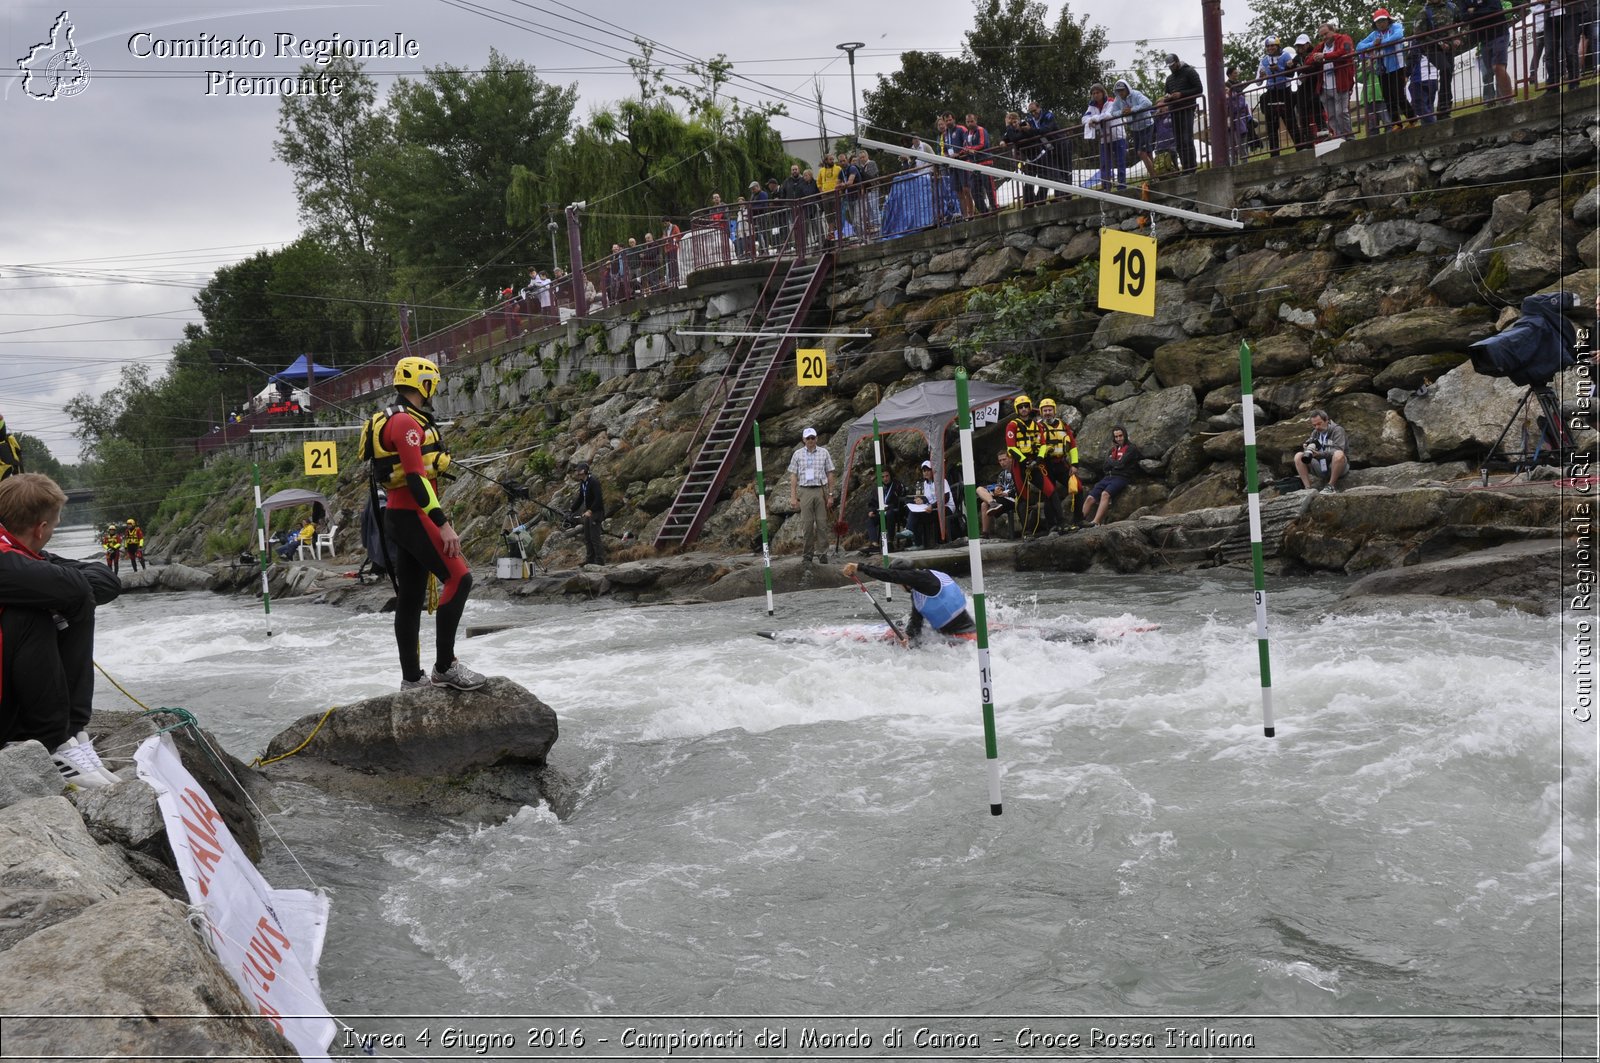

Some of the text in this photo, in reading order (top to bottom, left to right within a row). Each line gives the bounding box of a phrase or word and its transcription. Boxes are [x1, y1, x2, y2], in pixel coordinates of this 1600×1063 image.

[1112, 246, 1147, 298] 19
[802, 355, 823, 379] 20
[975, 411, 986, 421] 23
[987, 406, 998, 417] 24
[310, 447, 332, 469] 21
